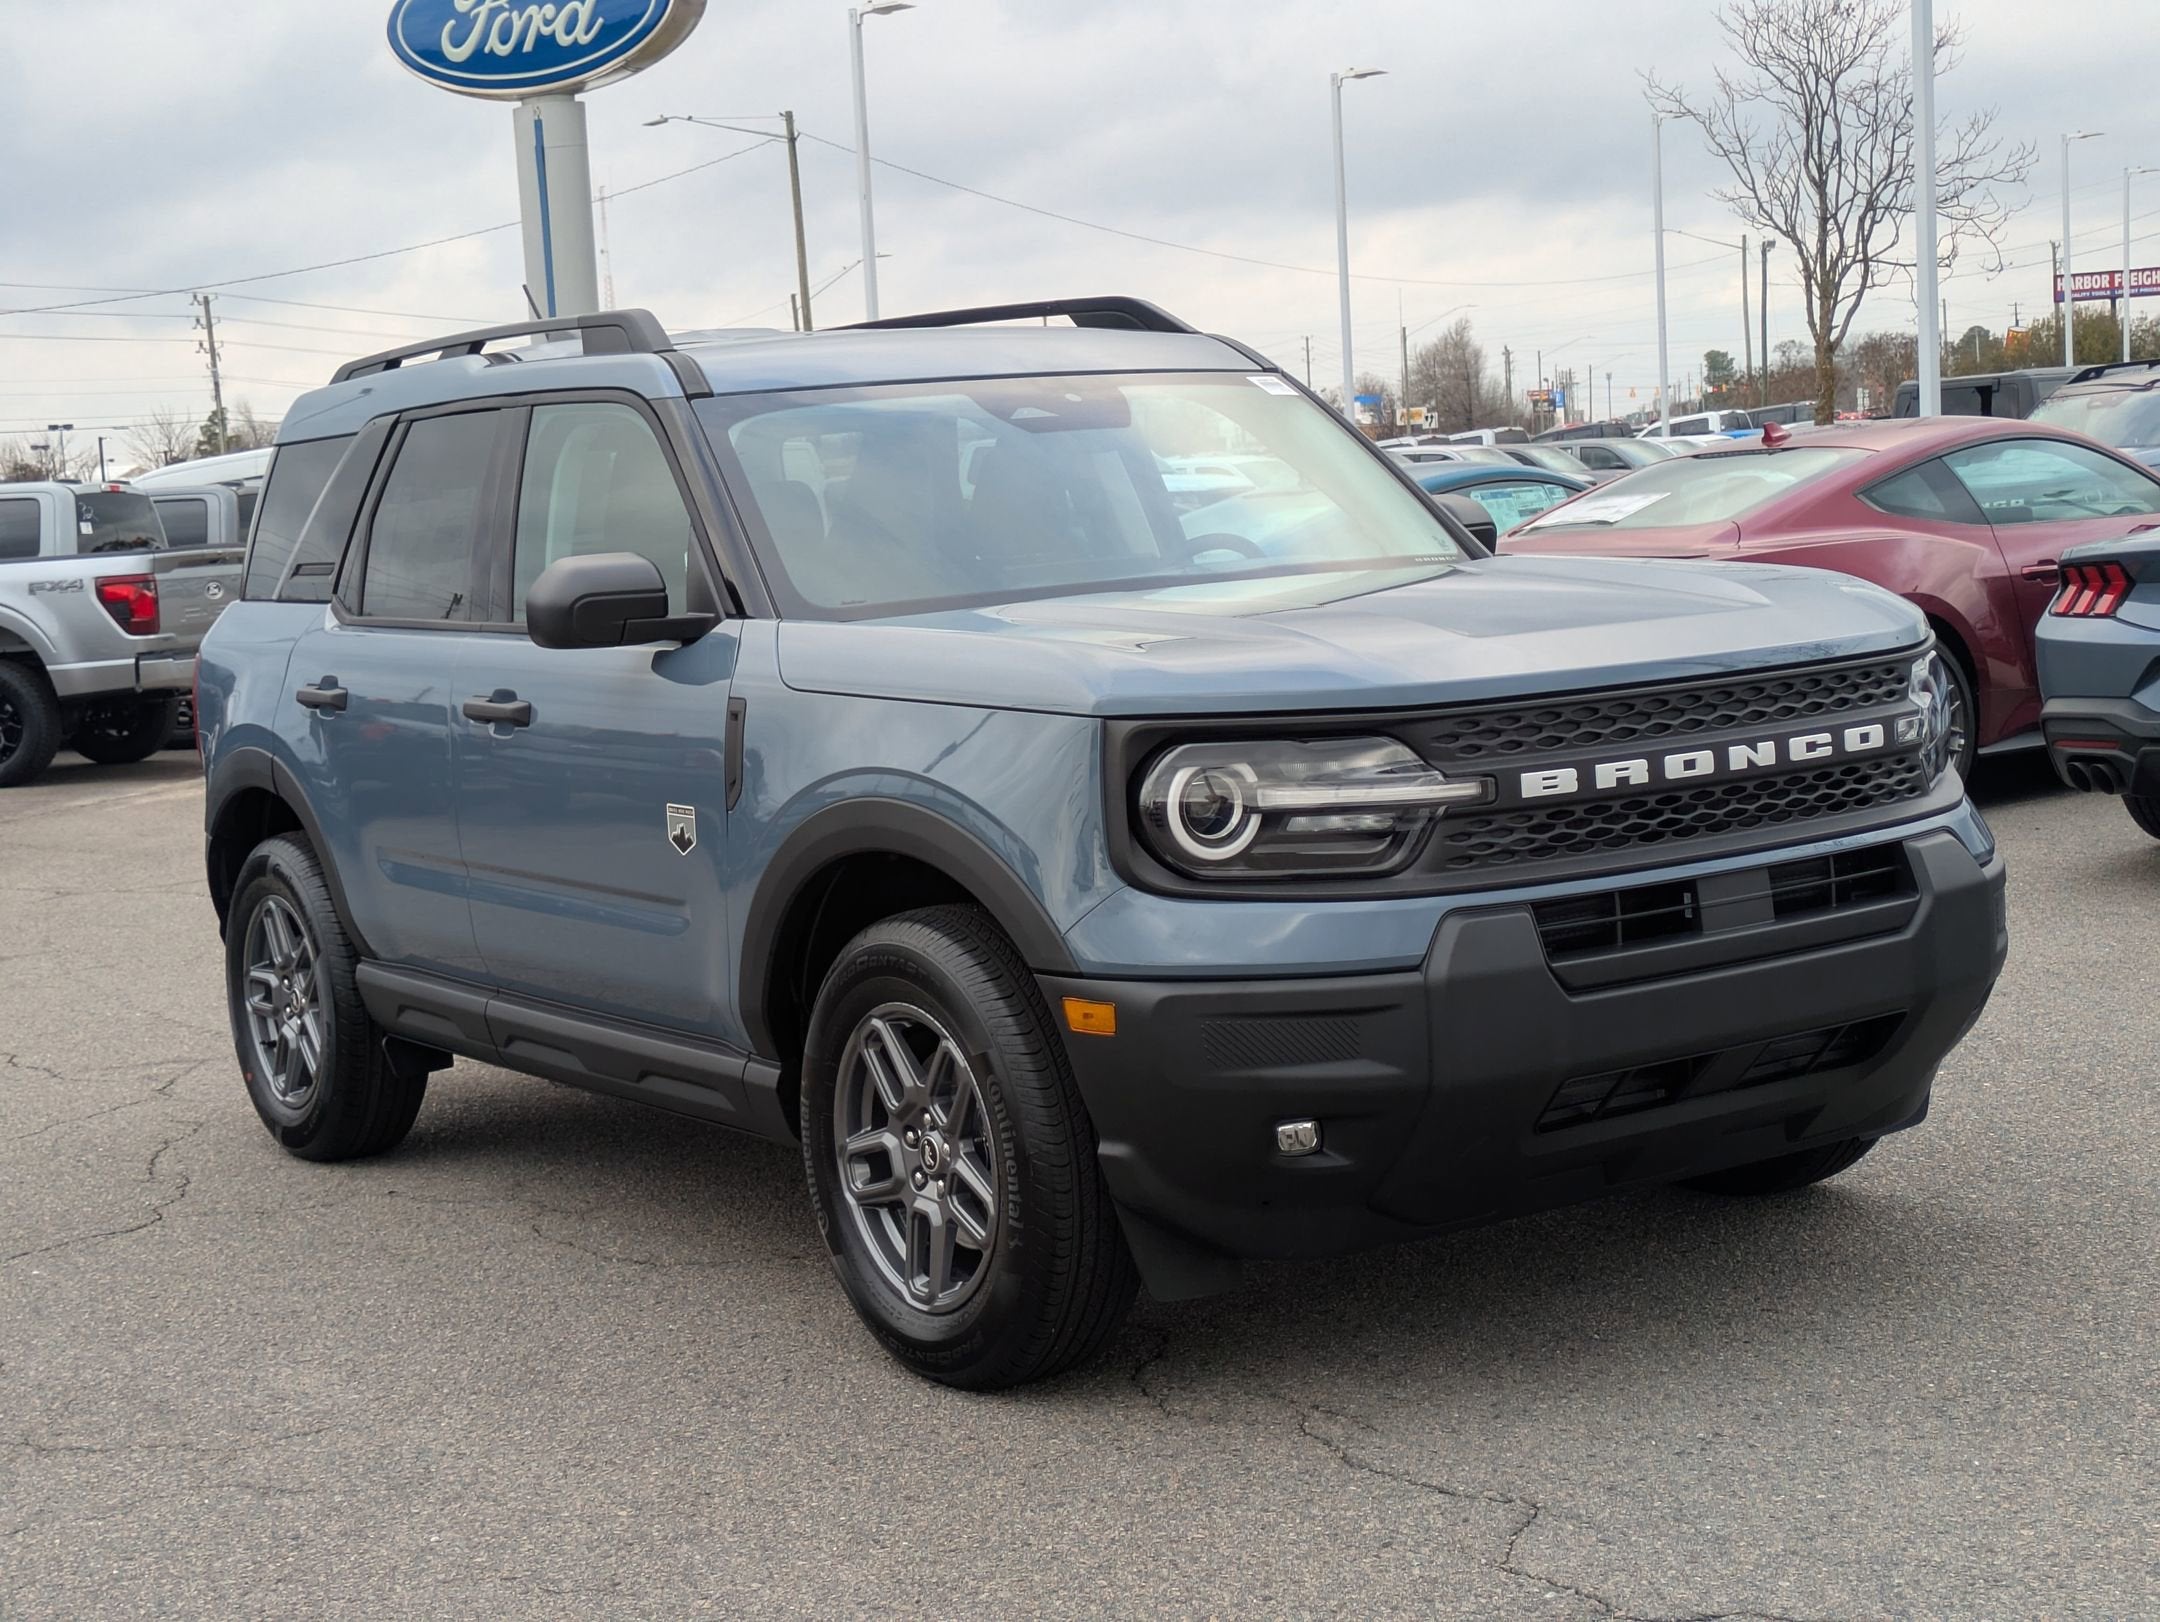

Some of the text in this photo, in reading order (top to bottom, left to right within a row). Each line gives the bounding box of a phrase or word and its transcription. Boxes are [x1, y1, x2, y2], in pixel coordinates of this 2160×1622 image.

[441, 0, 604, 62] Ford
[2114, 270, 2160, 288] FEIGH
[29, 579, 84, 596] FX4
[1520, 724, 1884, 799] BRONCO
[988, 1075, 1023, 1229] Continental
